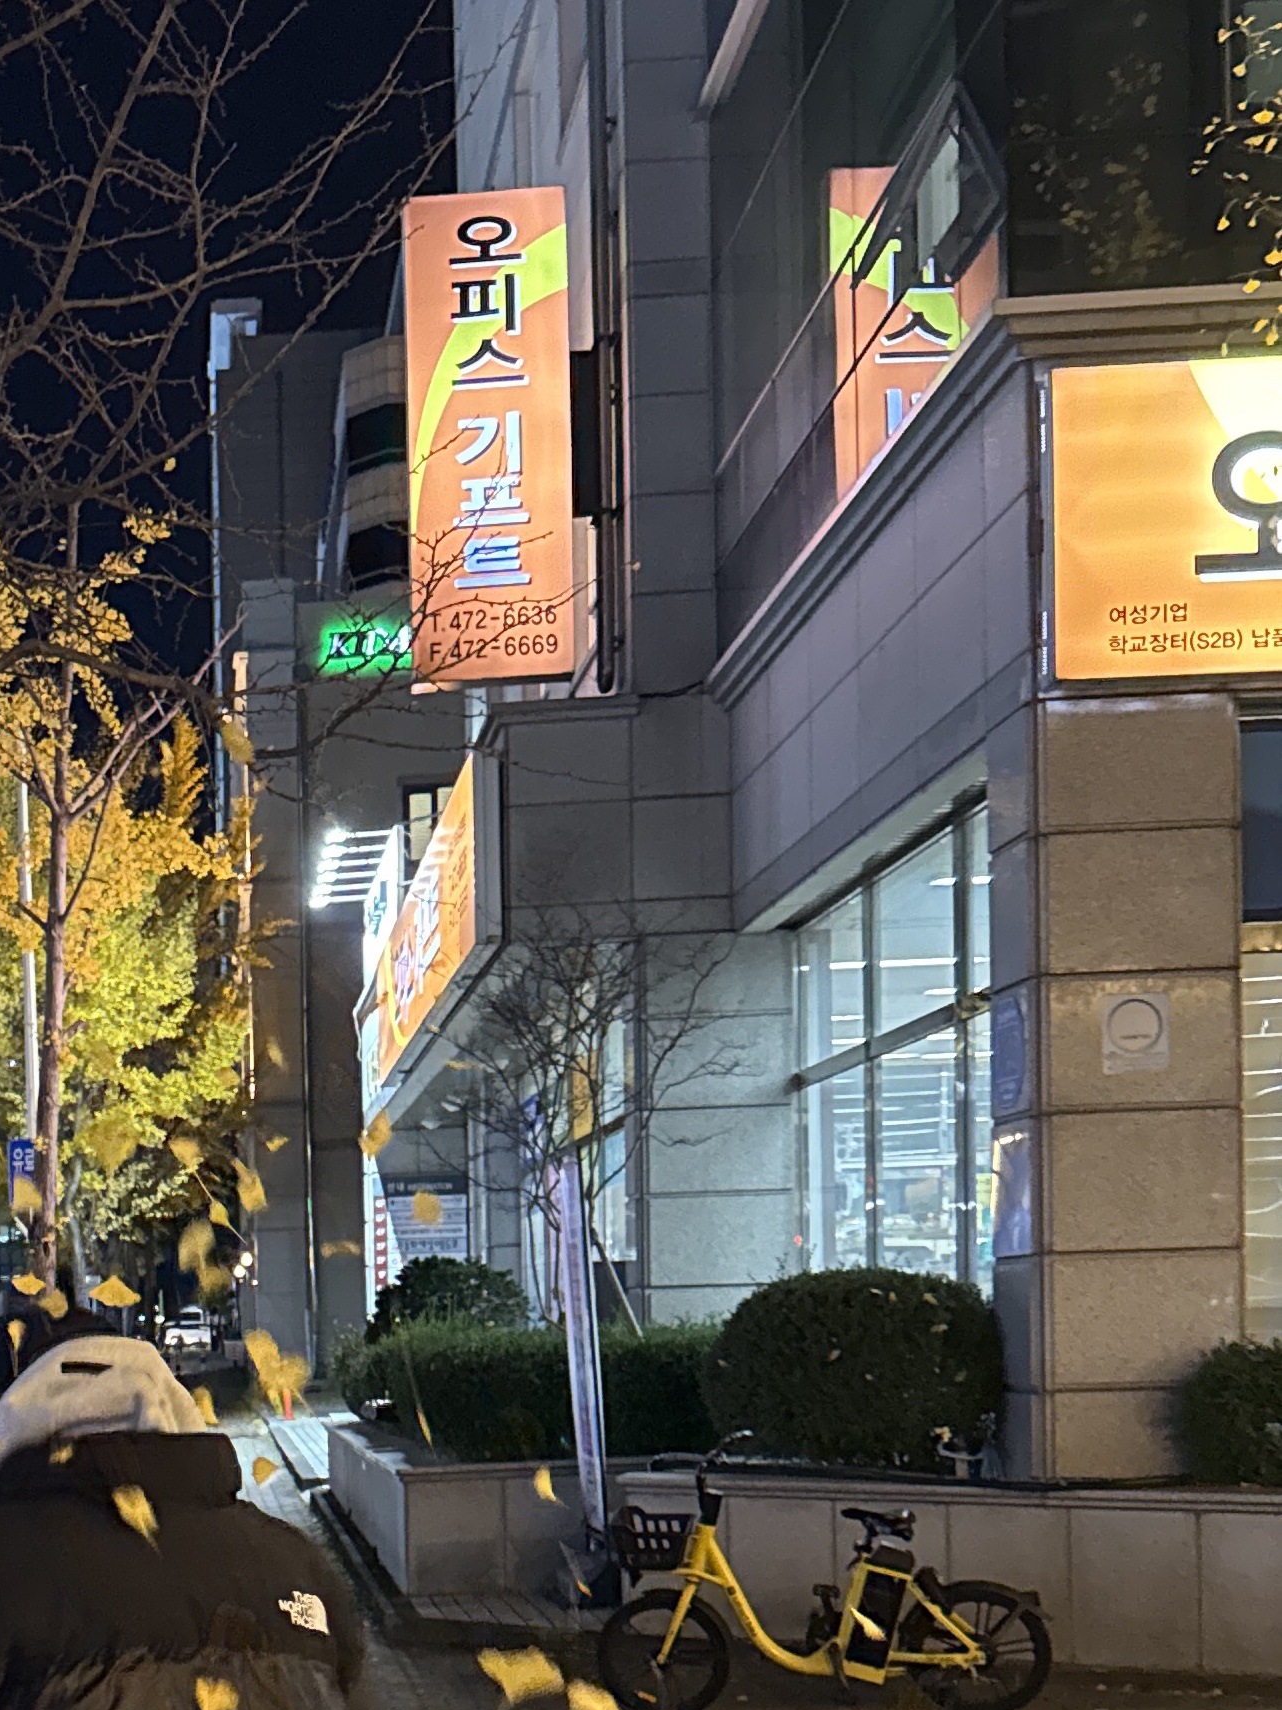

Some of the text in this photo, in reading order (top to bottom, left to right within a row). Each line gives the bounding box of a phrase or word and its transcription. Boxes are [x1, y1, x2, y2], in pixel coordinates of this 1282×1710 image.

[450, 216, 533, 589] 오피스 기프트
[430, 604, 557, 632] T.472-6636
[1109, 602, 1188, 625] 여성기업
[1108, 628, 1243, 655] 학교장터(S2B)
